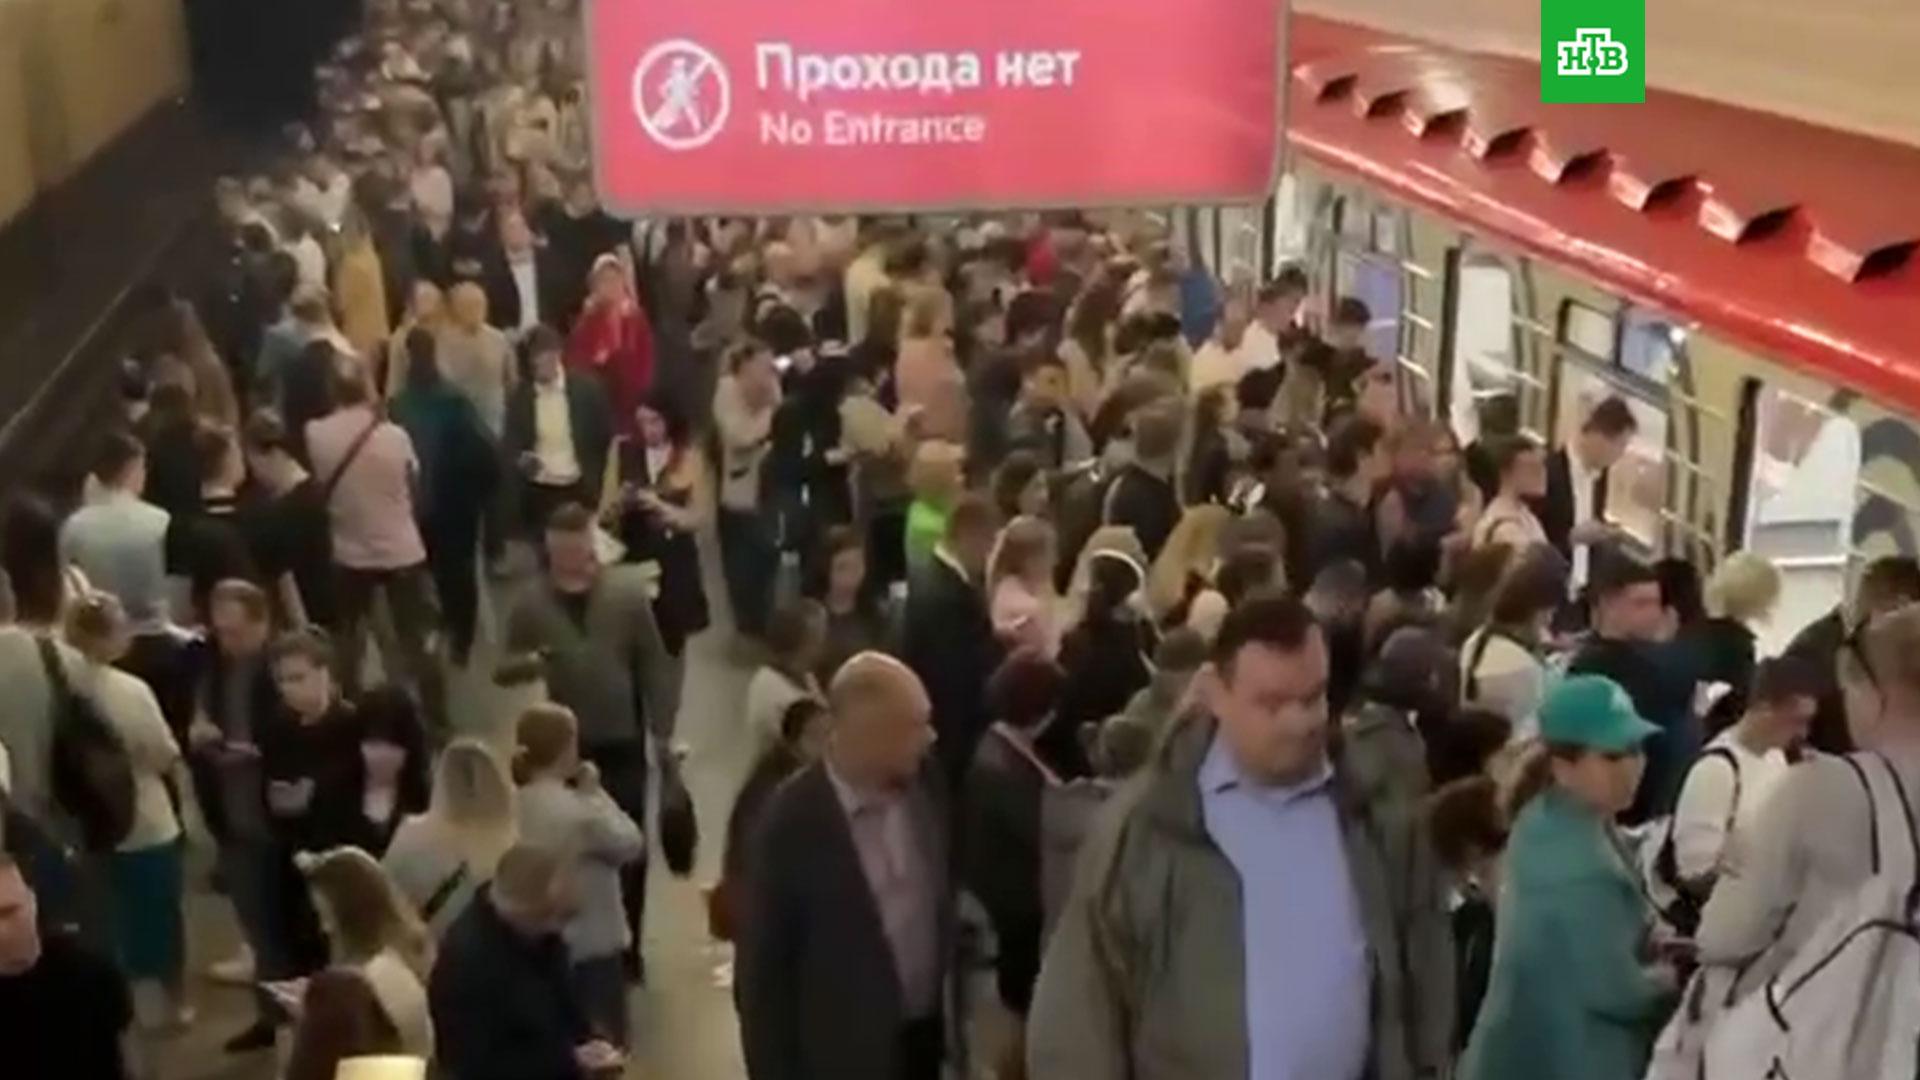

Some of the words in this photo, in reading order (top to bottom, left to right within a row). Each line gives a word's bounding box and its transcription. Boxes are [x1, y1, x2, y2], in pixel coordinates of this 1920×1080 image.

[755, 42, 980, 100] Прохода
[996, 50, 1081, 87] нет
[760, 112, 812, 144] No
[824, 112, 985, 144] Entrance
